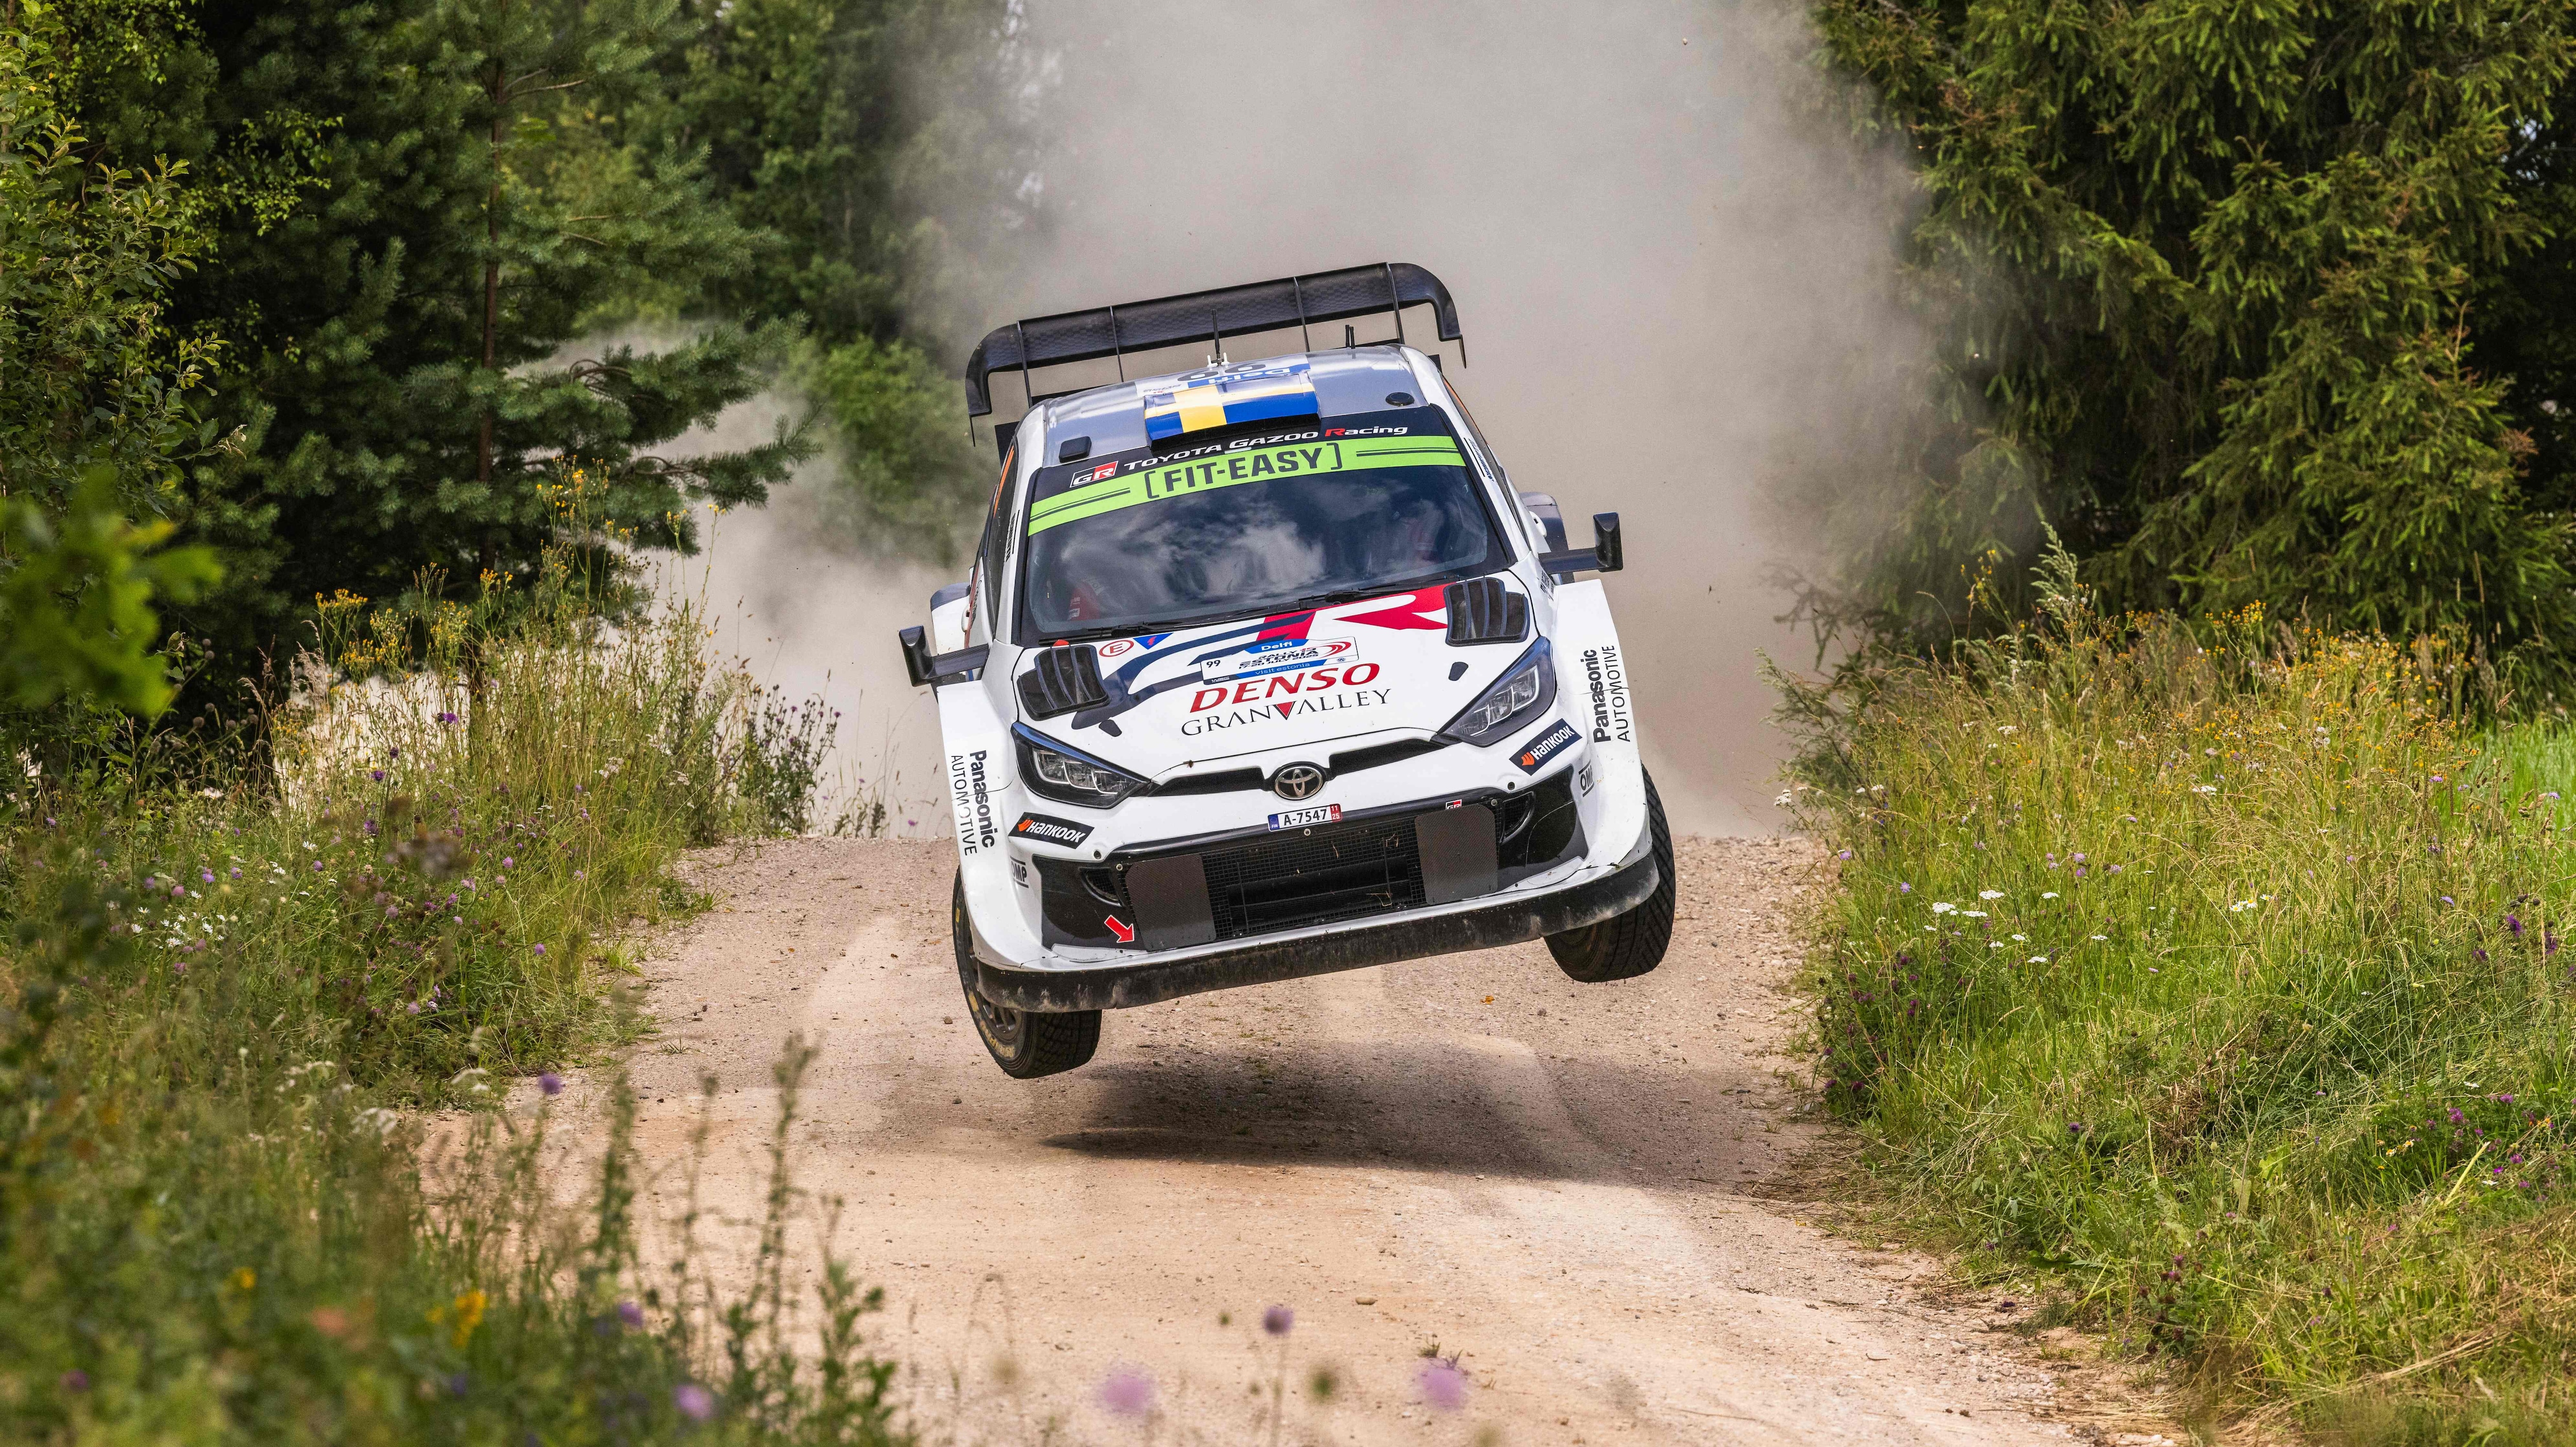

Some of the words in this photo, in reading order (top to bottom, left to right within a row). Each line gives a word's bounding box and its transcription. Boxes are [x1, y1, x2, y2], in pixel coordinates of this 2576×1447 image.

[1124, 445, 1222, 470] TOYOTA
[1229, 432, 1318, 449] GAZOO
[1325, 426, 1408, 437] Racing
[1073, 468, 1114, 485] GR
[1110, 643, 1123, 654] E
[1258, 651, 1299, 659] RALLY
[1261, 641, 1292, 651] Delfi
[1206, 659, 1221, 668] 99
[1240, 651, 1318, 666] ESTONIA
[1277, 662, 1310, 671] estonia
[1191, 663, 1380, 713] DENSO
[1580, 650, 1612, 743] Panasonic
[1601, 645, 1631, 742] AUTOMOTIVE
[1580, 764, 1594, 791] OMP
[951, 756, 978, 856] AUTOMOTIVE
[970, 750, 995, 848] Panasonic
[1283, 809, 1327, 826] A-7547
[1011, 861, 1027, 882] OMP
